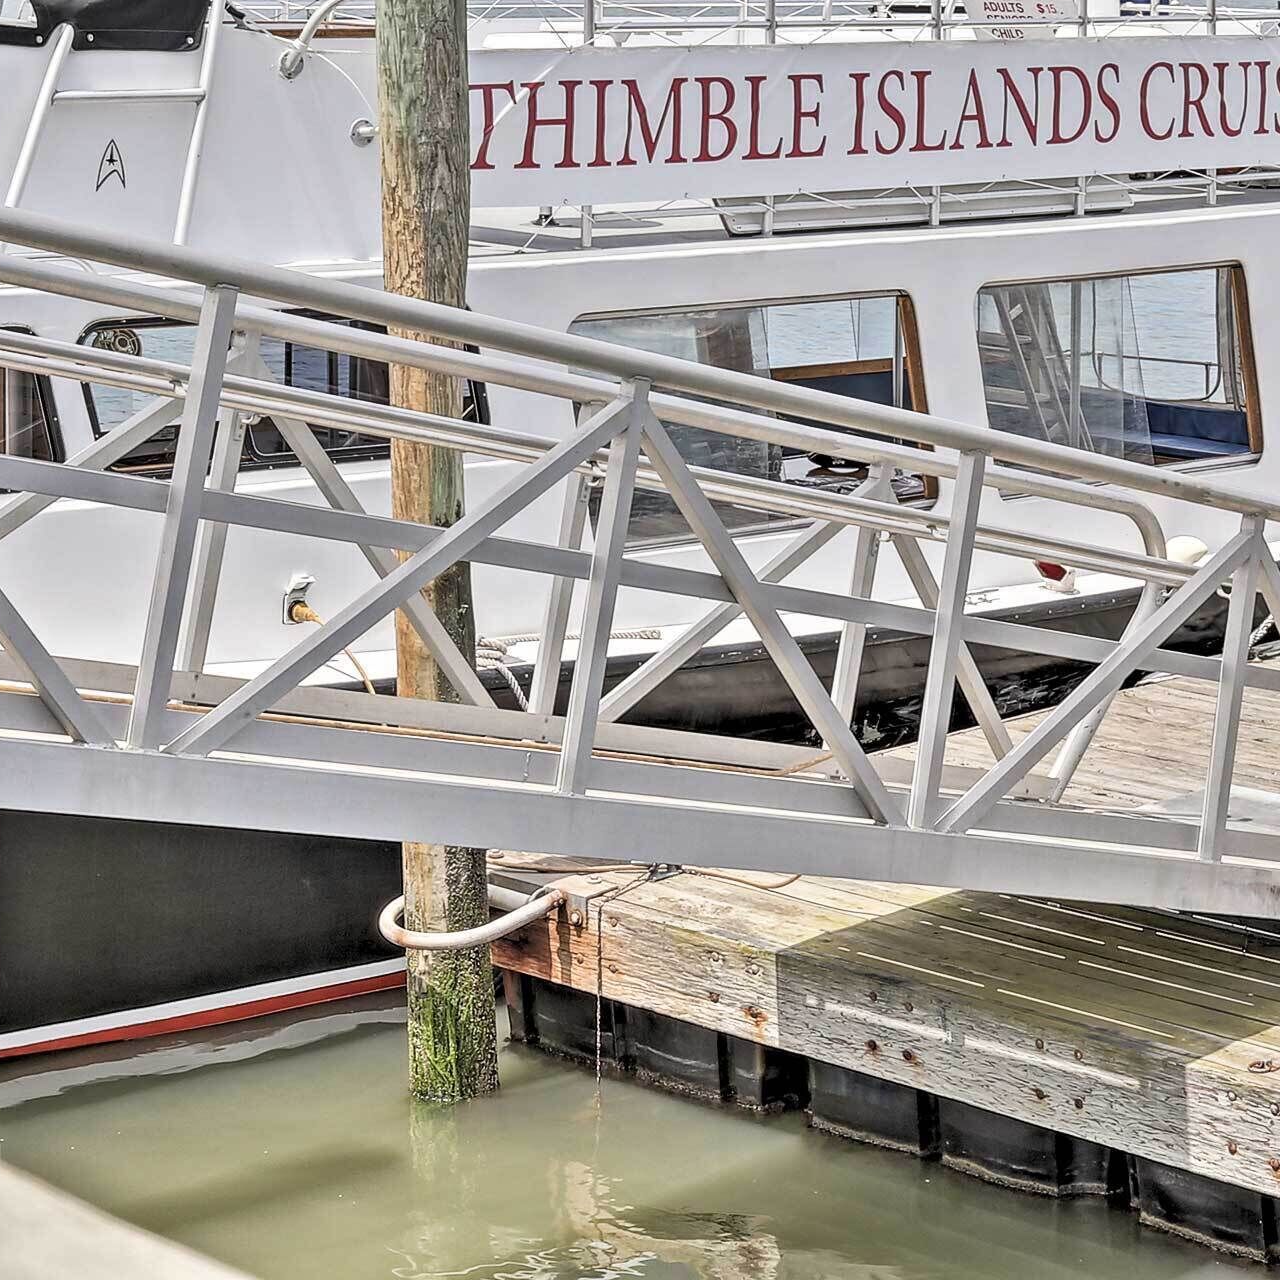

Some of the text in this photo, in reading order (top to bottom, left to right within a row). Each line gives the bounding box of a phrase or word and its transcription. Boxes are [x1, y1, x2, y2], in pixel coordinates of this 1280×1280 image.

[983, 1, 1025, 14] ADULTS
[469, 72, 827, 170] THIMBLE
[847, 62, 1121, 156] ISLANDS
